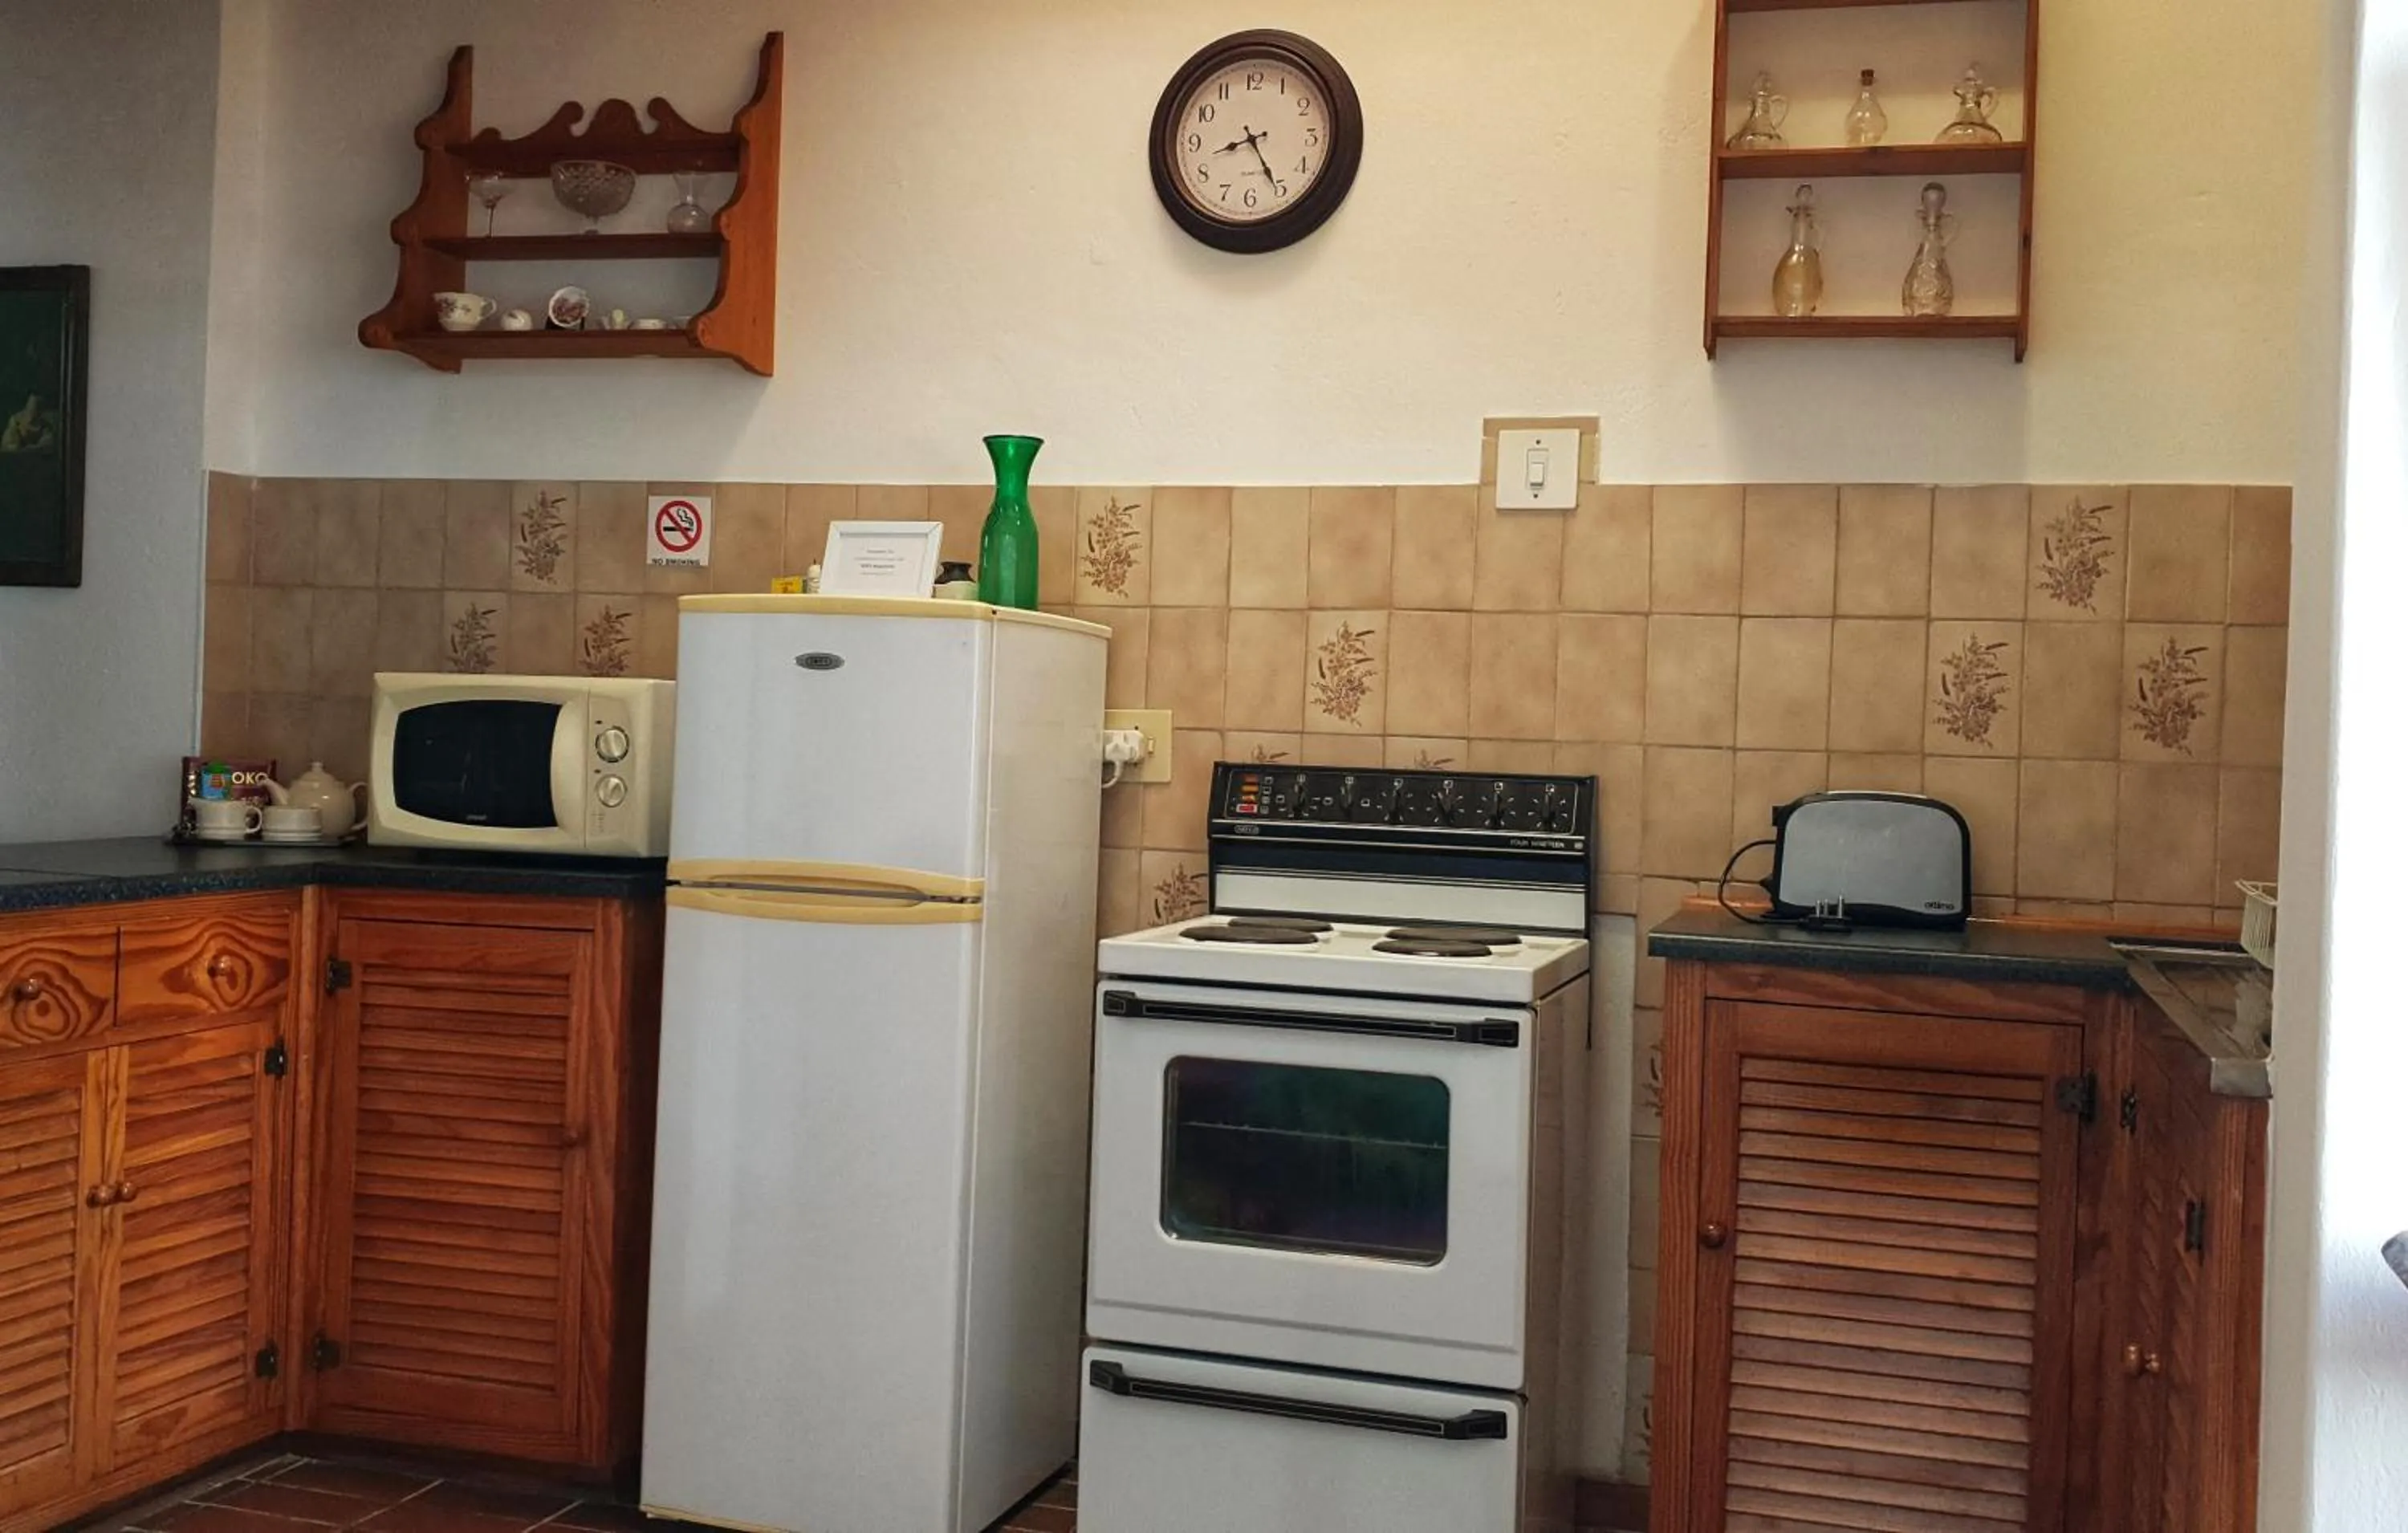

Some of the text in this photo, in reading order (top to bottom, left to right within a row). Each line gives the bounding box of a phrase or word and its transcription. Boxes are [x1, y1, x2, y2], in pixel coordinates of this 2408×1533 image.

[1246, 71, 1264, 91] 12
[1279, 77, 1285, 96] 1
[1218, 82, 1229, 100] 11
[1198, 104, 1215, 123] 10
[1297, 97, 1311, 116] 2
[1188, 133, 1202, 152] 9
[1304, 128, 1318, 147] 3
[1198, 163, 1210, 183] 8
[1294, 156, 1309, 174] 4
[1219, 184, 1231, 201] 7
[1274, 179, 1287, 197] 5
[1243, 188, 1257, 208] 6
